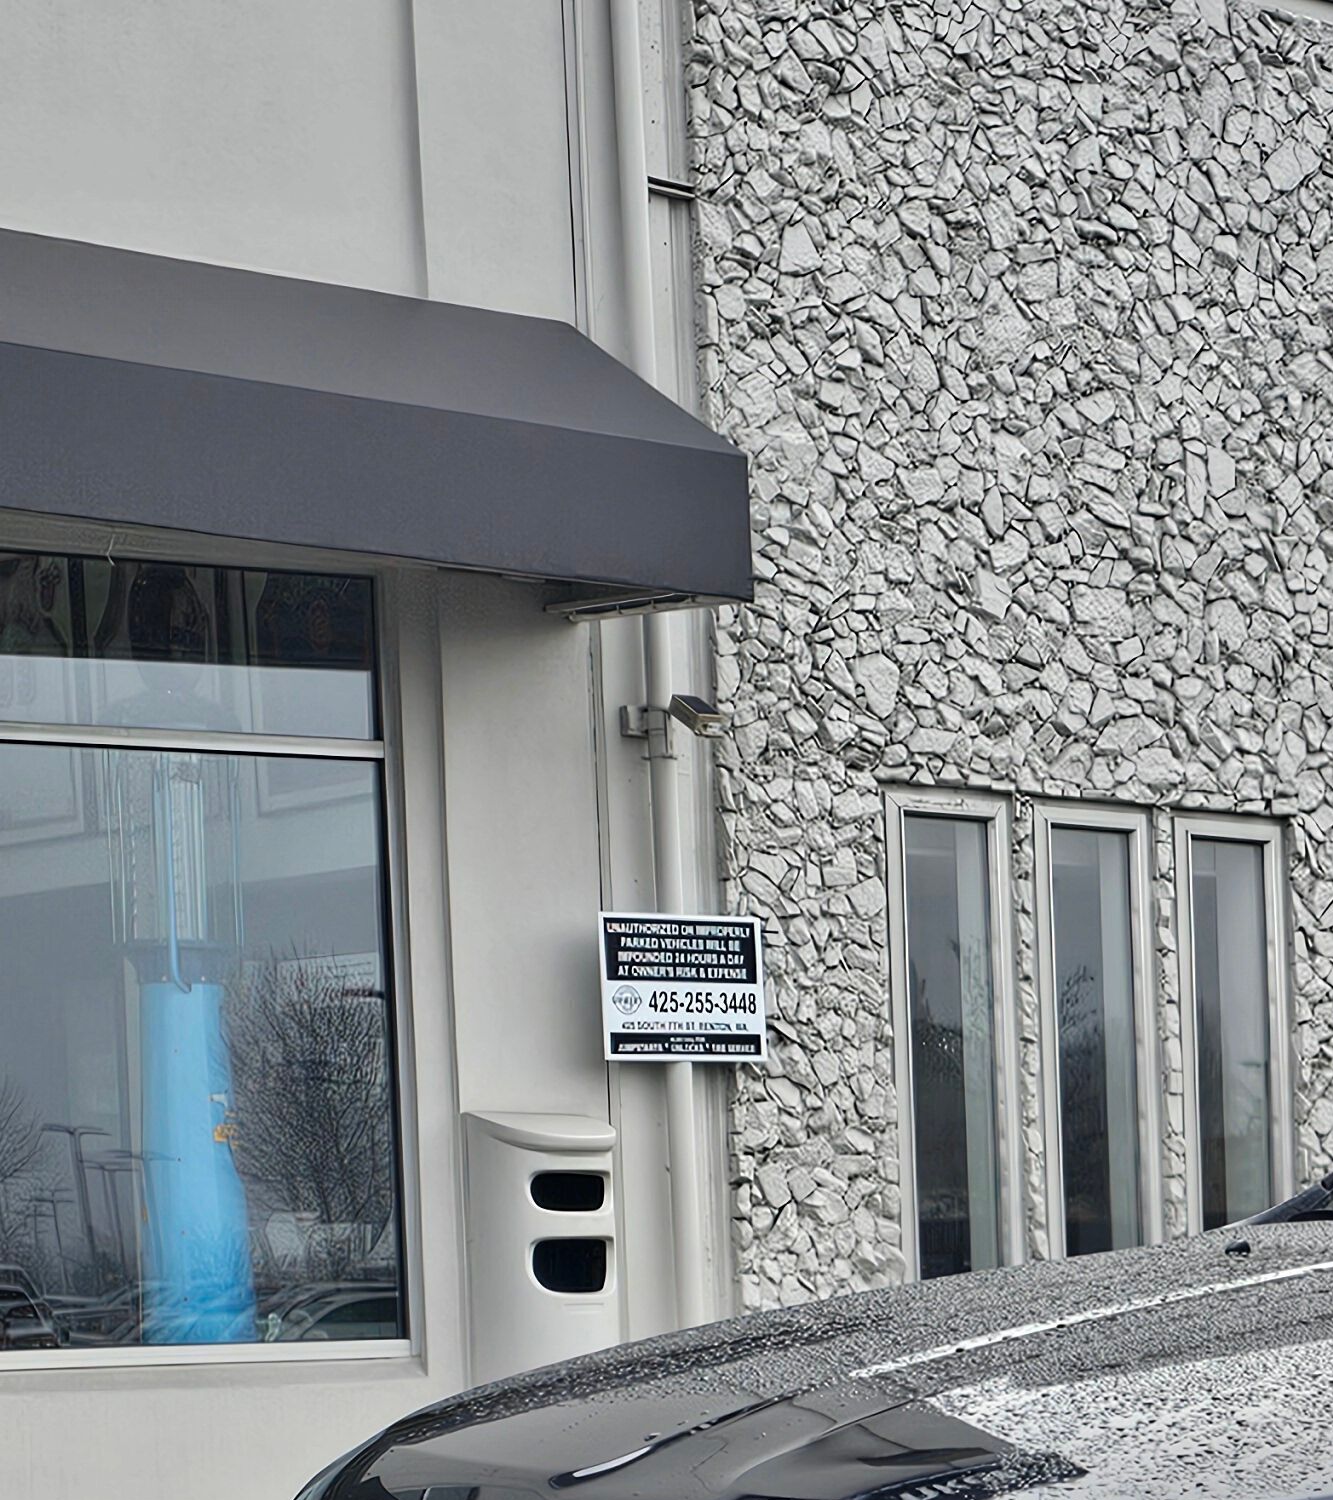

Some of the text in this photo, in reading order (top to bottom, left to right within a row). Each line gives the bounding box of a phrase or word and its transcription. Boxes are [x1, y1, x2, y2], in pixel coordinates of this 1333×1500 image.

[660, 938, 704, 950] VEHICLES
[706, 940, 726, 951] WILL
[618, 951, 673, 963] IMPOUNDED
[687, 953, 718, 964] HOURS
[720, 954, 727, 965] A
[728, 954, 744, 965] DAY
[618, 965, 630, 976] AT
[708, 968, 747, 979] EXPENSE
[648, 991, 757, 1014] 425-255-3448
